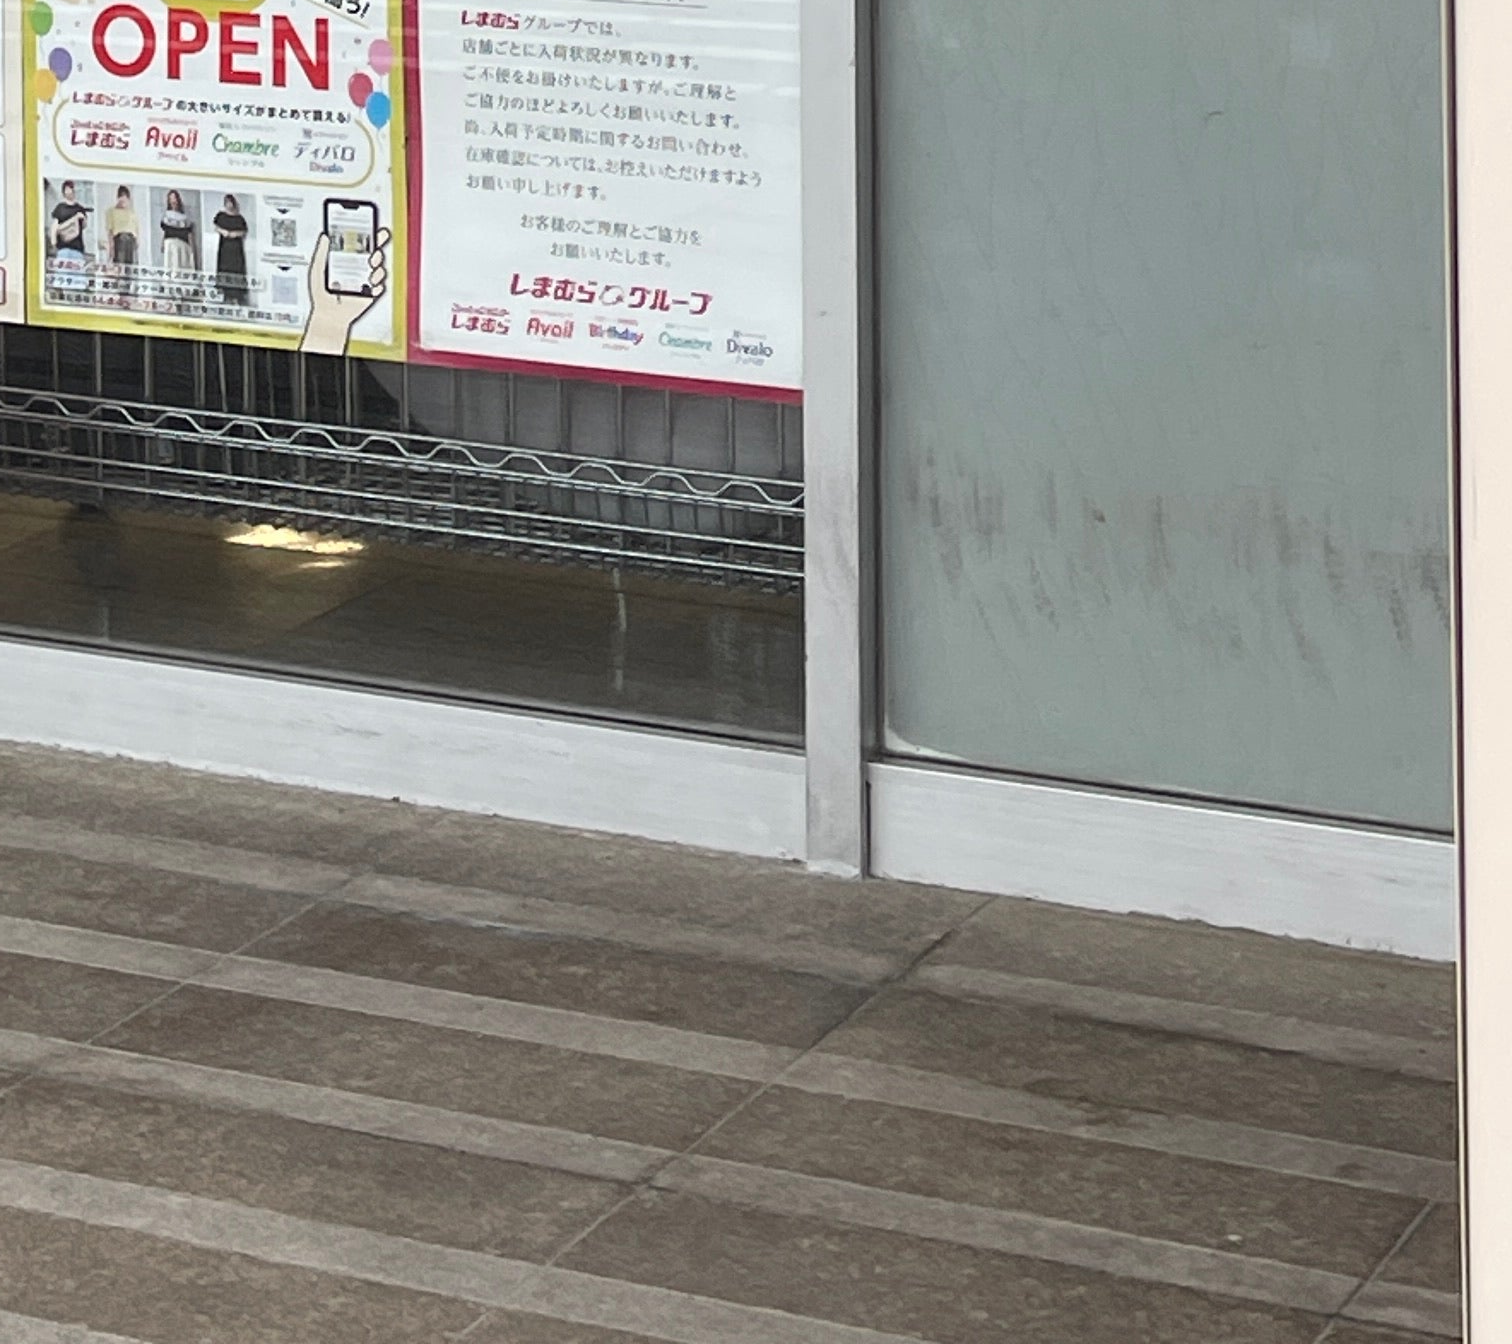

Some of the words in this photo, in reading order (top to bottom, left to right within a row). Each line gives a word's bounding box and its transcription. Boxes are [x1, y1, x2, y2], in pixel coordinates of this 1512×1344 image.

[91, 3, 330, 91] OPEN
[70, 129, 131, 151] しまむら
[144, 125, 199, 151] Avail
[211, 132, 281, 158] Chambre
[294, 141, 356, 162] ディバロ
[510, 272, 714, 315] しまむらグループ
[450, 313, 511, 336] しまむら
[526, 315, 575, 340] Avail
